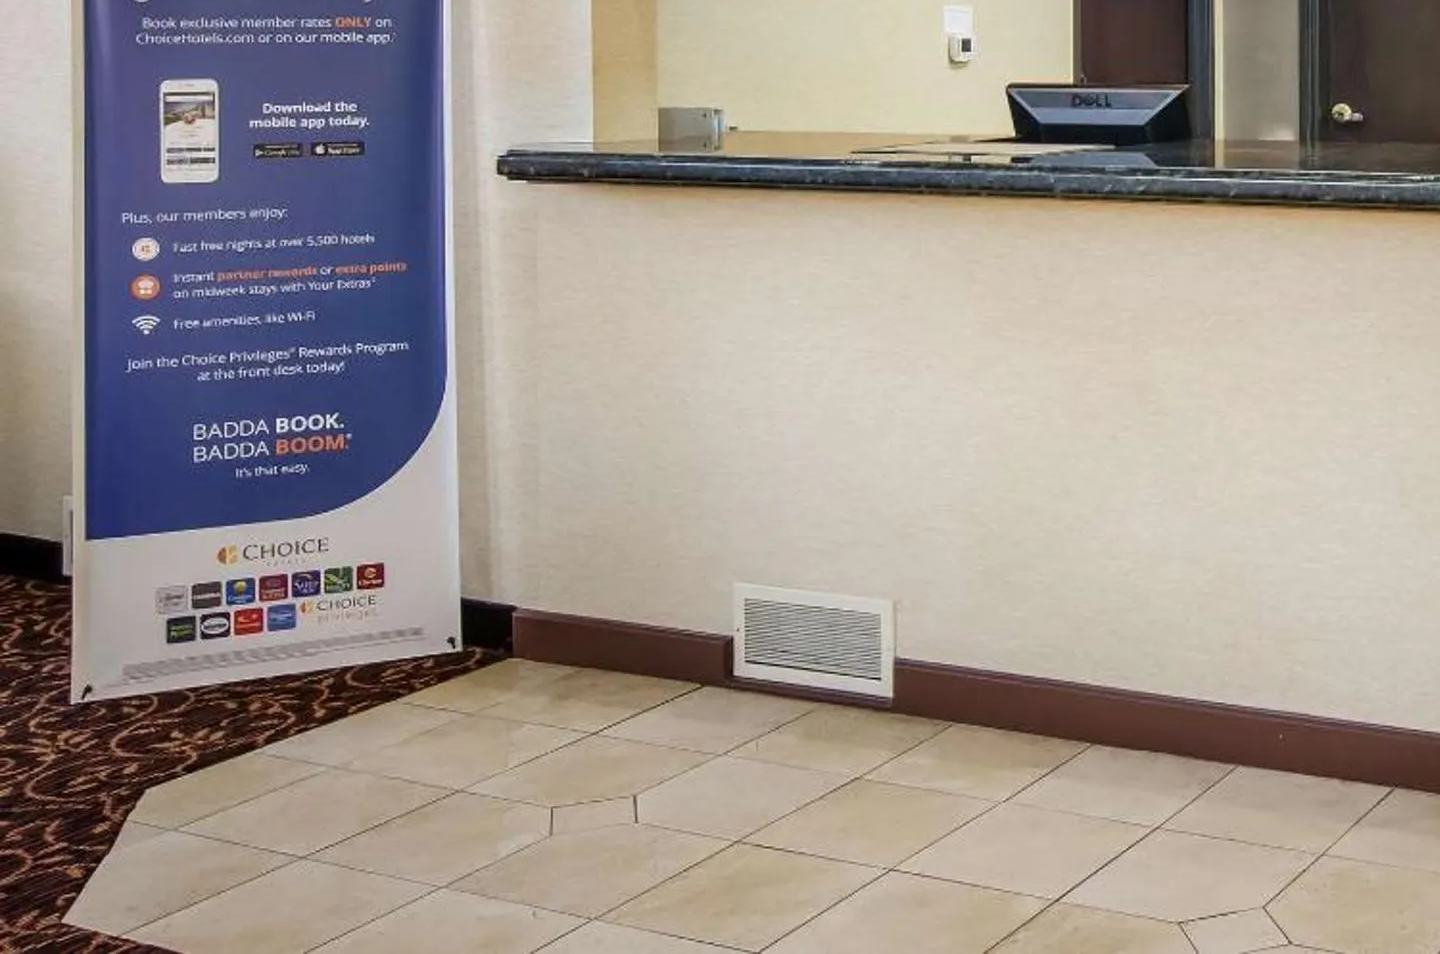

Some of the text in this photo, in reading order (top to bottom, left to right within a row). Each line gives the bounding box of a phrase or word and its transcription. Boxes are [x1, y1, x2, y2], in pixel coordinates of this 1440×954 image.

[142, 16, 392, 29] Book exclusive member rates ONLY on
[135, 32, 254, 45] ChoiceHotels.com
[257, 33, 273, 44] or
[275, 33, 292, 44] on
[294, 33, 317, 44] our
[320, 31, 364, 44] mobile
[262, 101, 358, 114] Download the
[1071, 93, 1112, 108] DELL
[249, 115, 370, 129] mobile app today.
[121, 207, 288, 224] Plus, our members enjoy:
[264, 238, 276, 249] at
[173, 261, 408, 283] Instant partner rewards or extra points
[173, 289, 189, 299] on
[192, 285, 246, 298] midweek
[248, 283, 277, 296] stays
[280, 281, 306, 293] with
[308, 279, 334, 291] Your
[125, 358, 153, 373] Join
[157, 356, 179, 368] the
[181, 353, 227, 366] Choice
[299, 344, 353, 358] Rewards
[356, 341, 410, 356] Program
[197, 371, 211, 381] at
[214, 367, 235, 380] the
[237, 365, 270, 378] front
[274, 362, 304, 376] desk
[193, 412, 345, 441] BADDA BOOK.
[193, 441, 270, 463] BADDA
[254, 464, 278, 477] that
[242, 537, 330, 561] CHOICE
[316, 594, 378, 611] CHOICE
